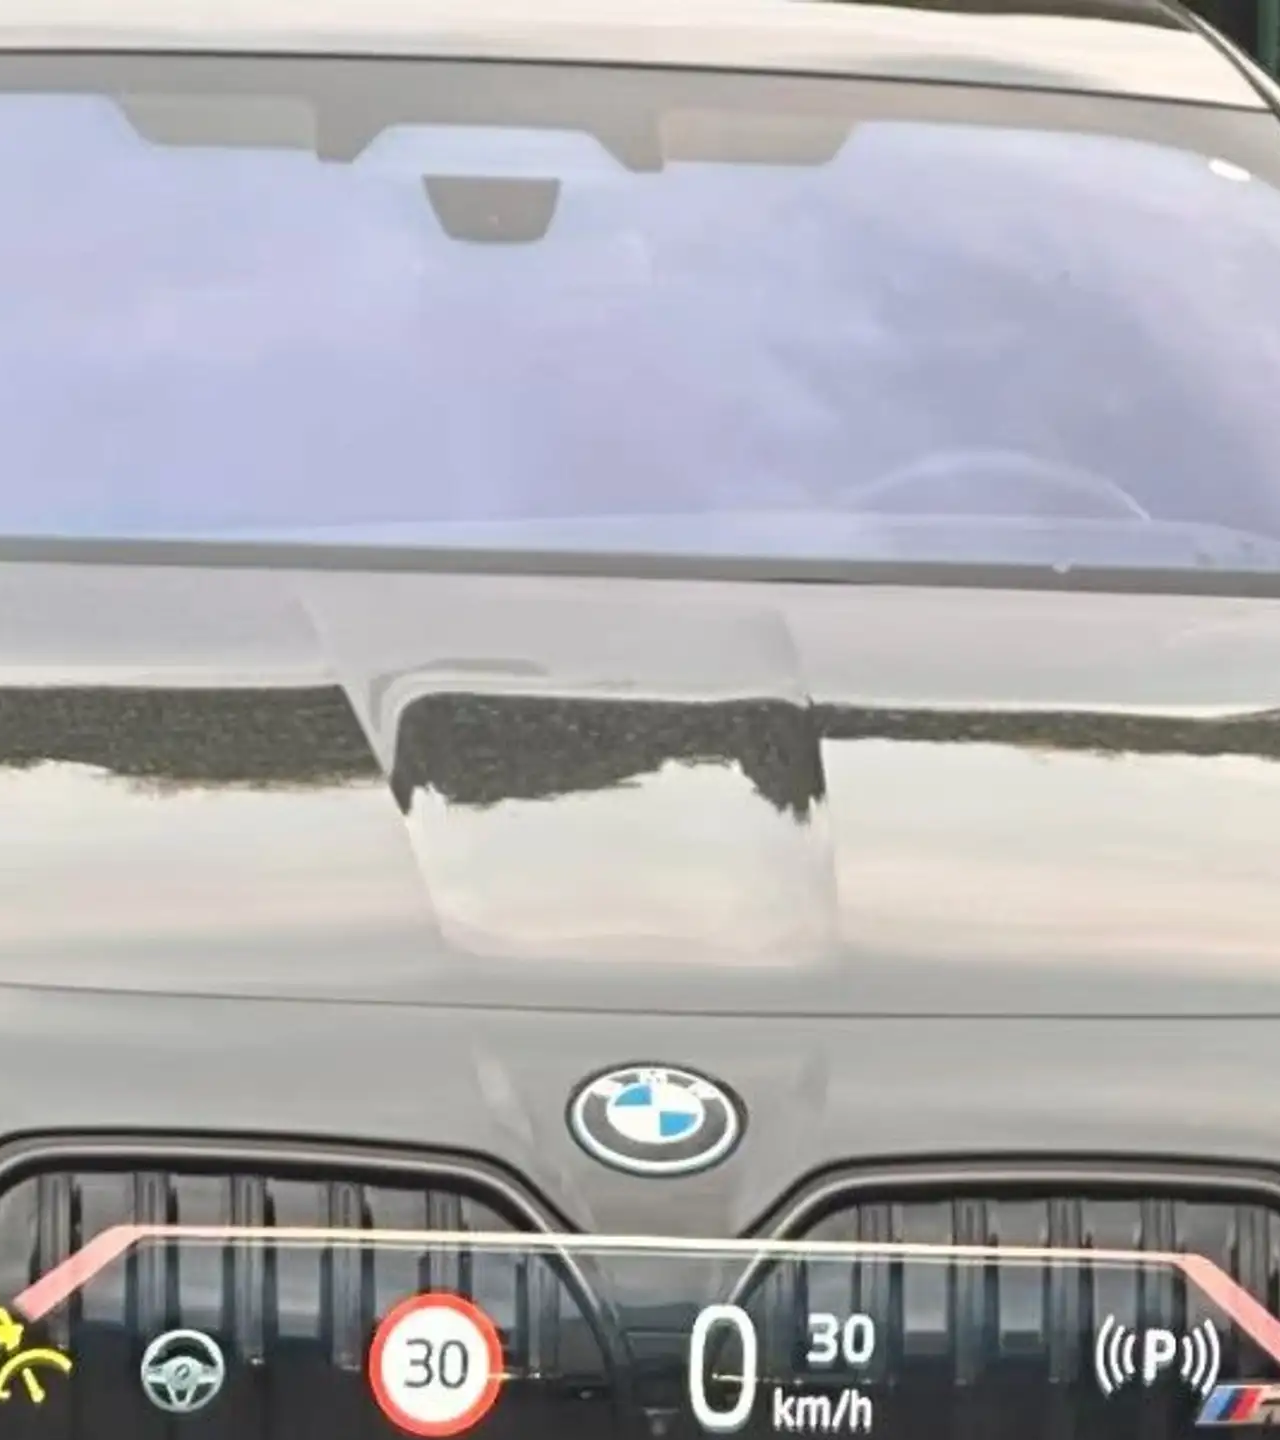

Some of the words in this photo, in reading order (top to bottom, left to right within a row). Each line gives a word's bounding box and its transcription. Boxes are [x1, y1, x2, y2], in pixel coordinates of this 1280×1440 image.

[404, 1338, 469, 1389] 30
[806, 1313, 875, 1364] 30
[1143, 1328, 1176, 1386] P
[690, 1304, 757, 1430] 0
[773, 1386, 873, 1431] km/h
